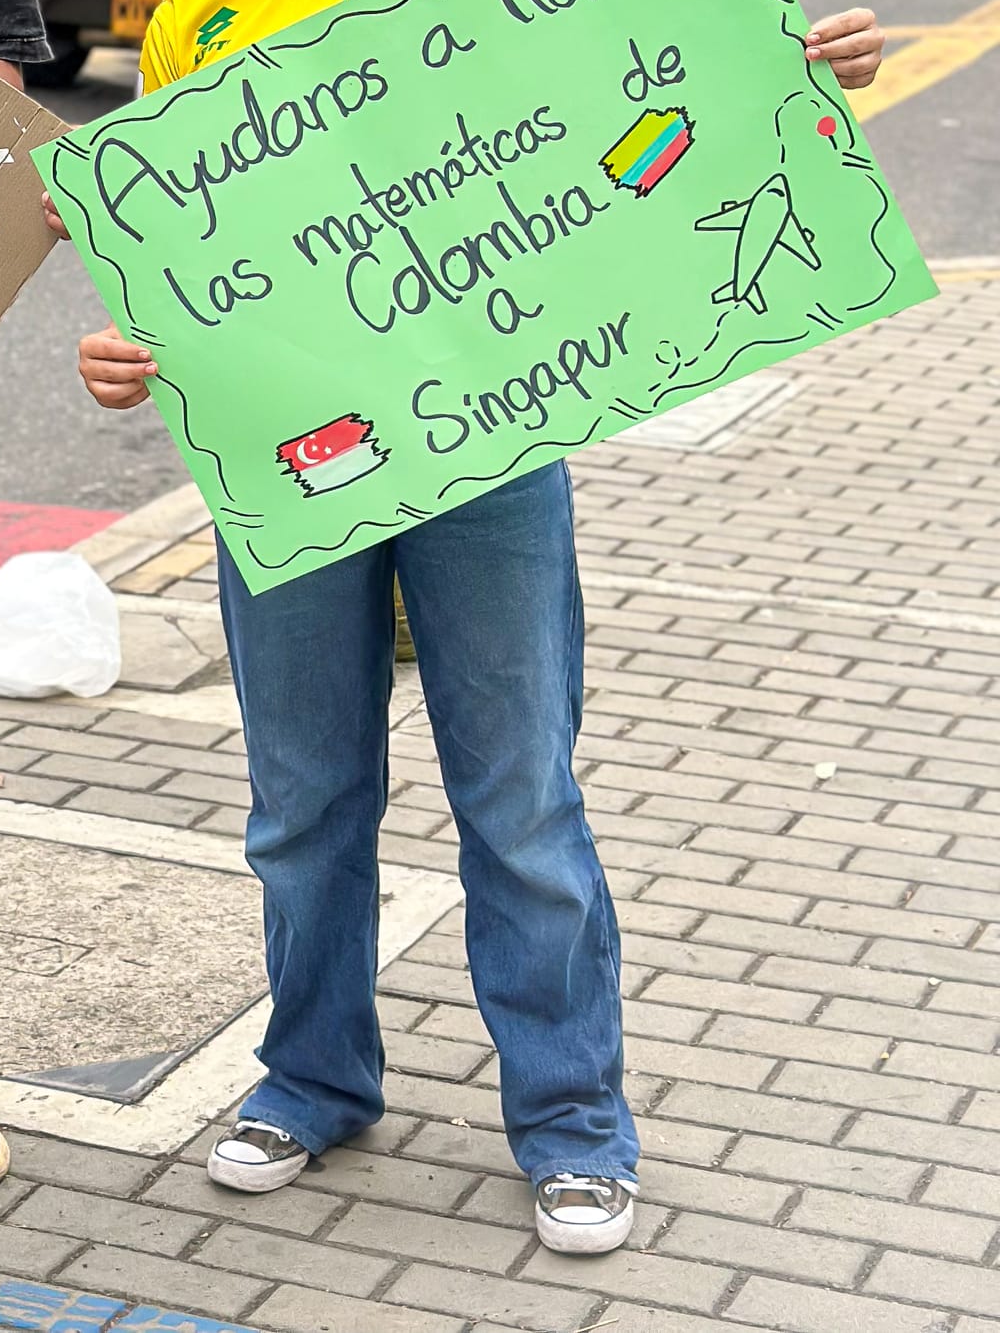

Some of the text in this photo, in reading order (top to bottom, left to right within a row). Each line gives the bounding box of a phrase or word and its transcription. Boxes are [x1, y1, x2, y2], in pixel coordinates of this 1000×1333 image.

[94, 58, 389, 243] Ayudanos
[422, 23, 477, 68] a
[164, 38, 687, 328] las matemáticas de
[345, 180, 611, 334] Colombia
[486, 286, 545, 335] a
[411, 311, 631, 454] Singapur
